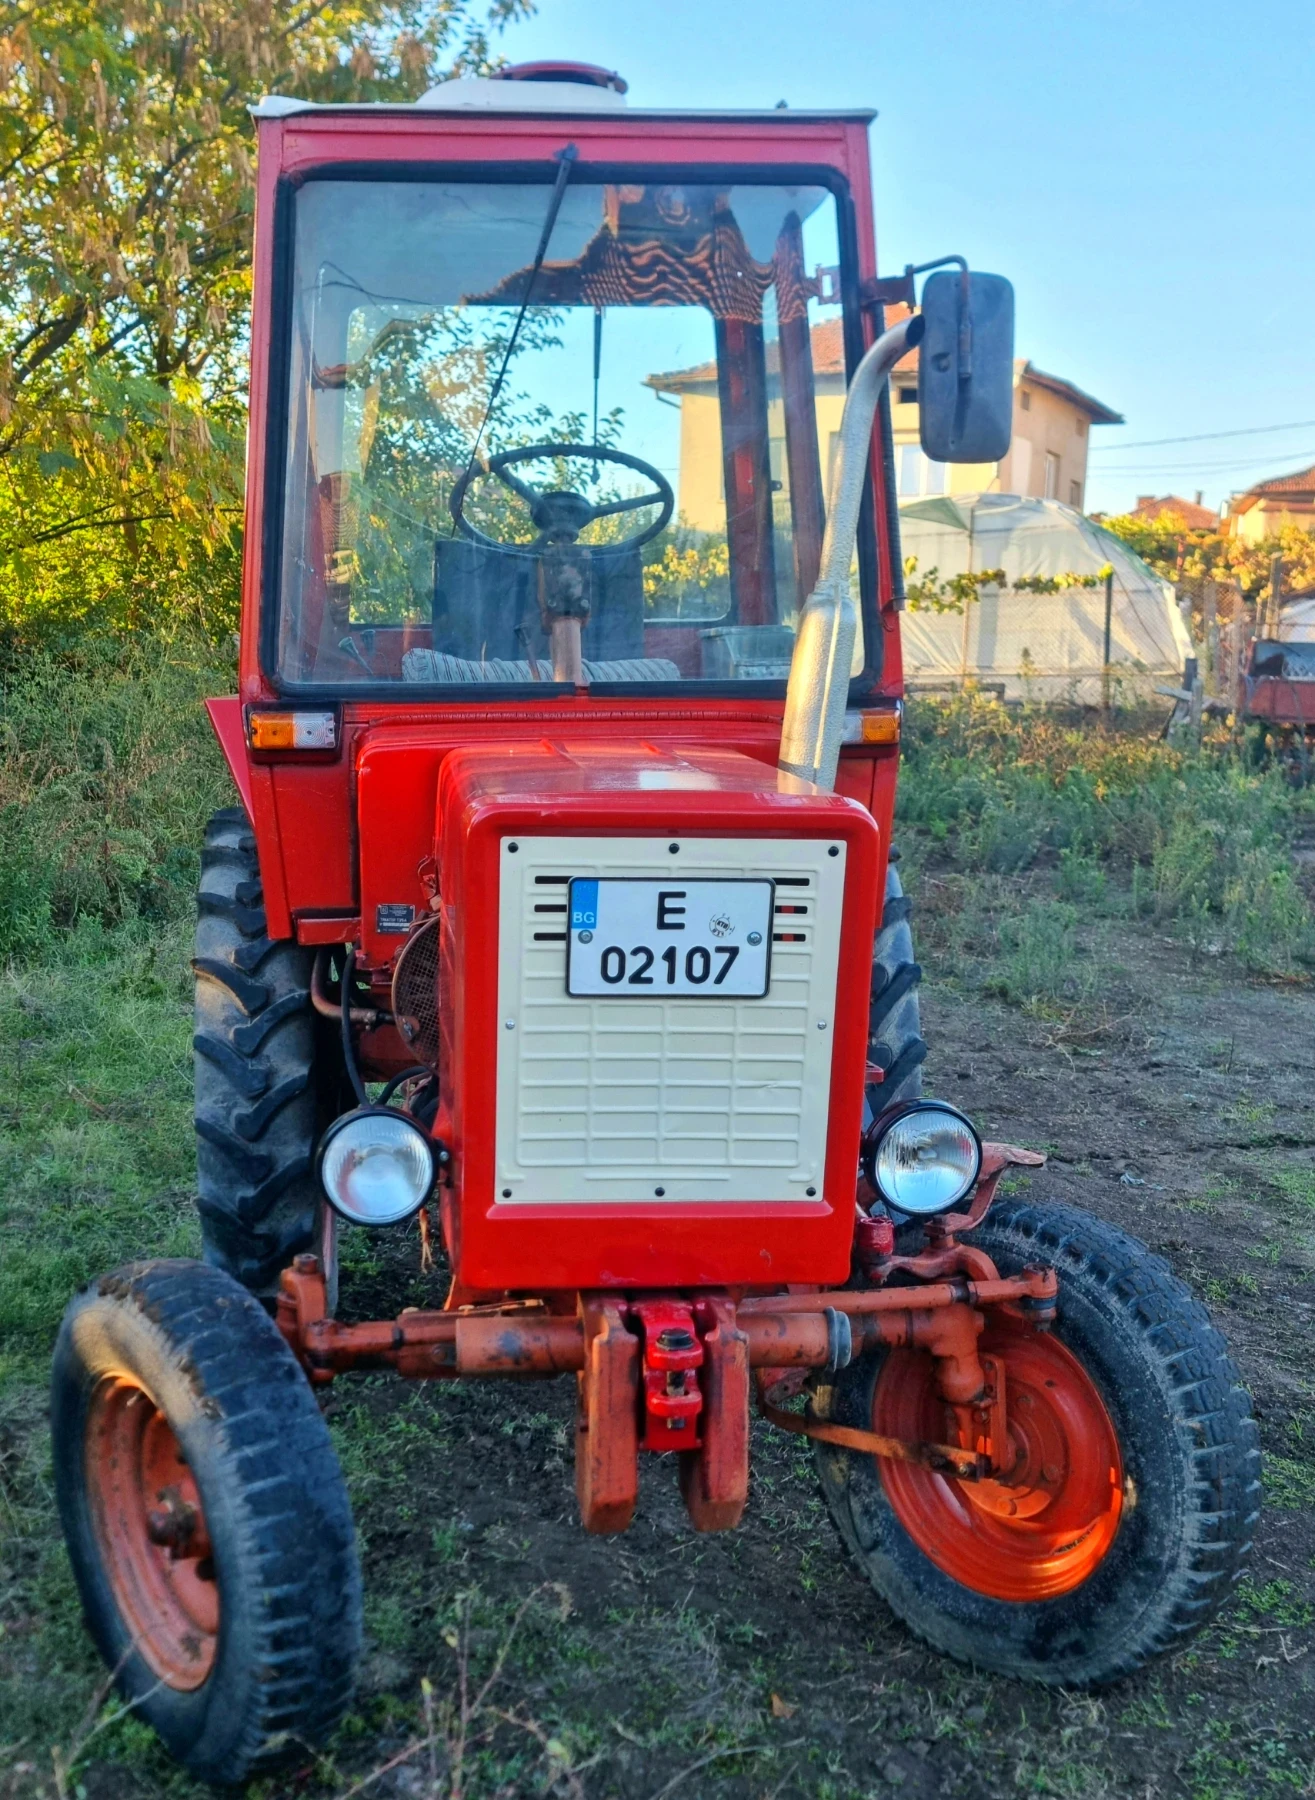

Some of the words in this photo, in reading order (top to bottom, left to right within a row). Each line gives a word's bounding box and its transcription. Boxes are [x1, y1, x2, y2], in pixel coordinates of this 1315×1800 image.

[573, 912, 595, 924] BG
[657, 891, 687, 930] E
[600, 945, 740, 985] 02107
